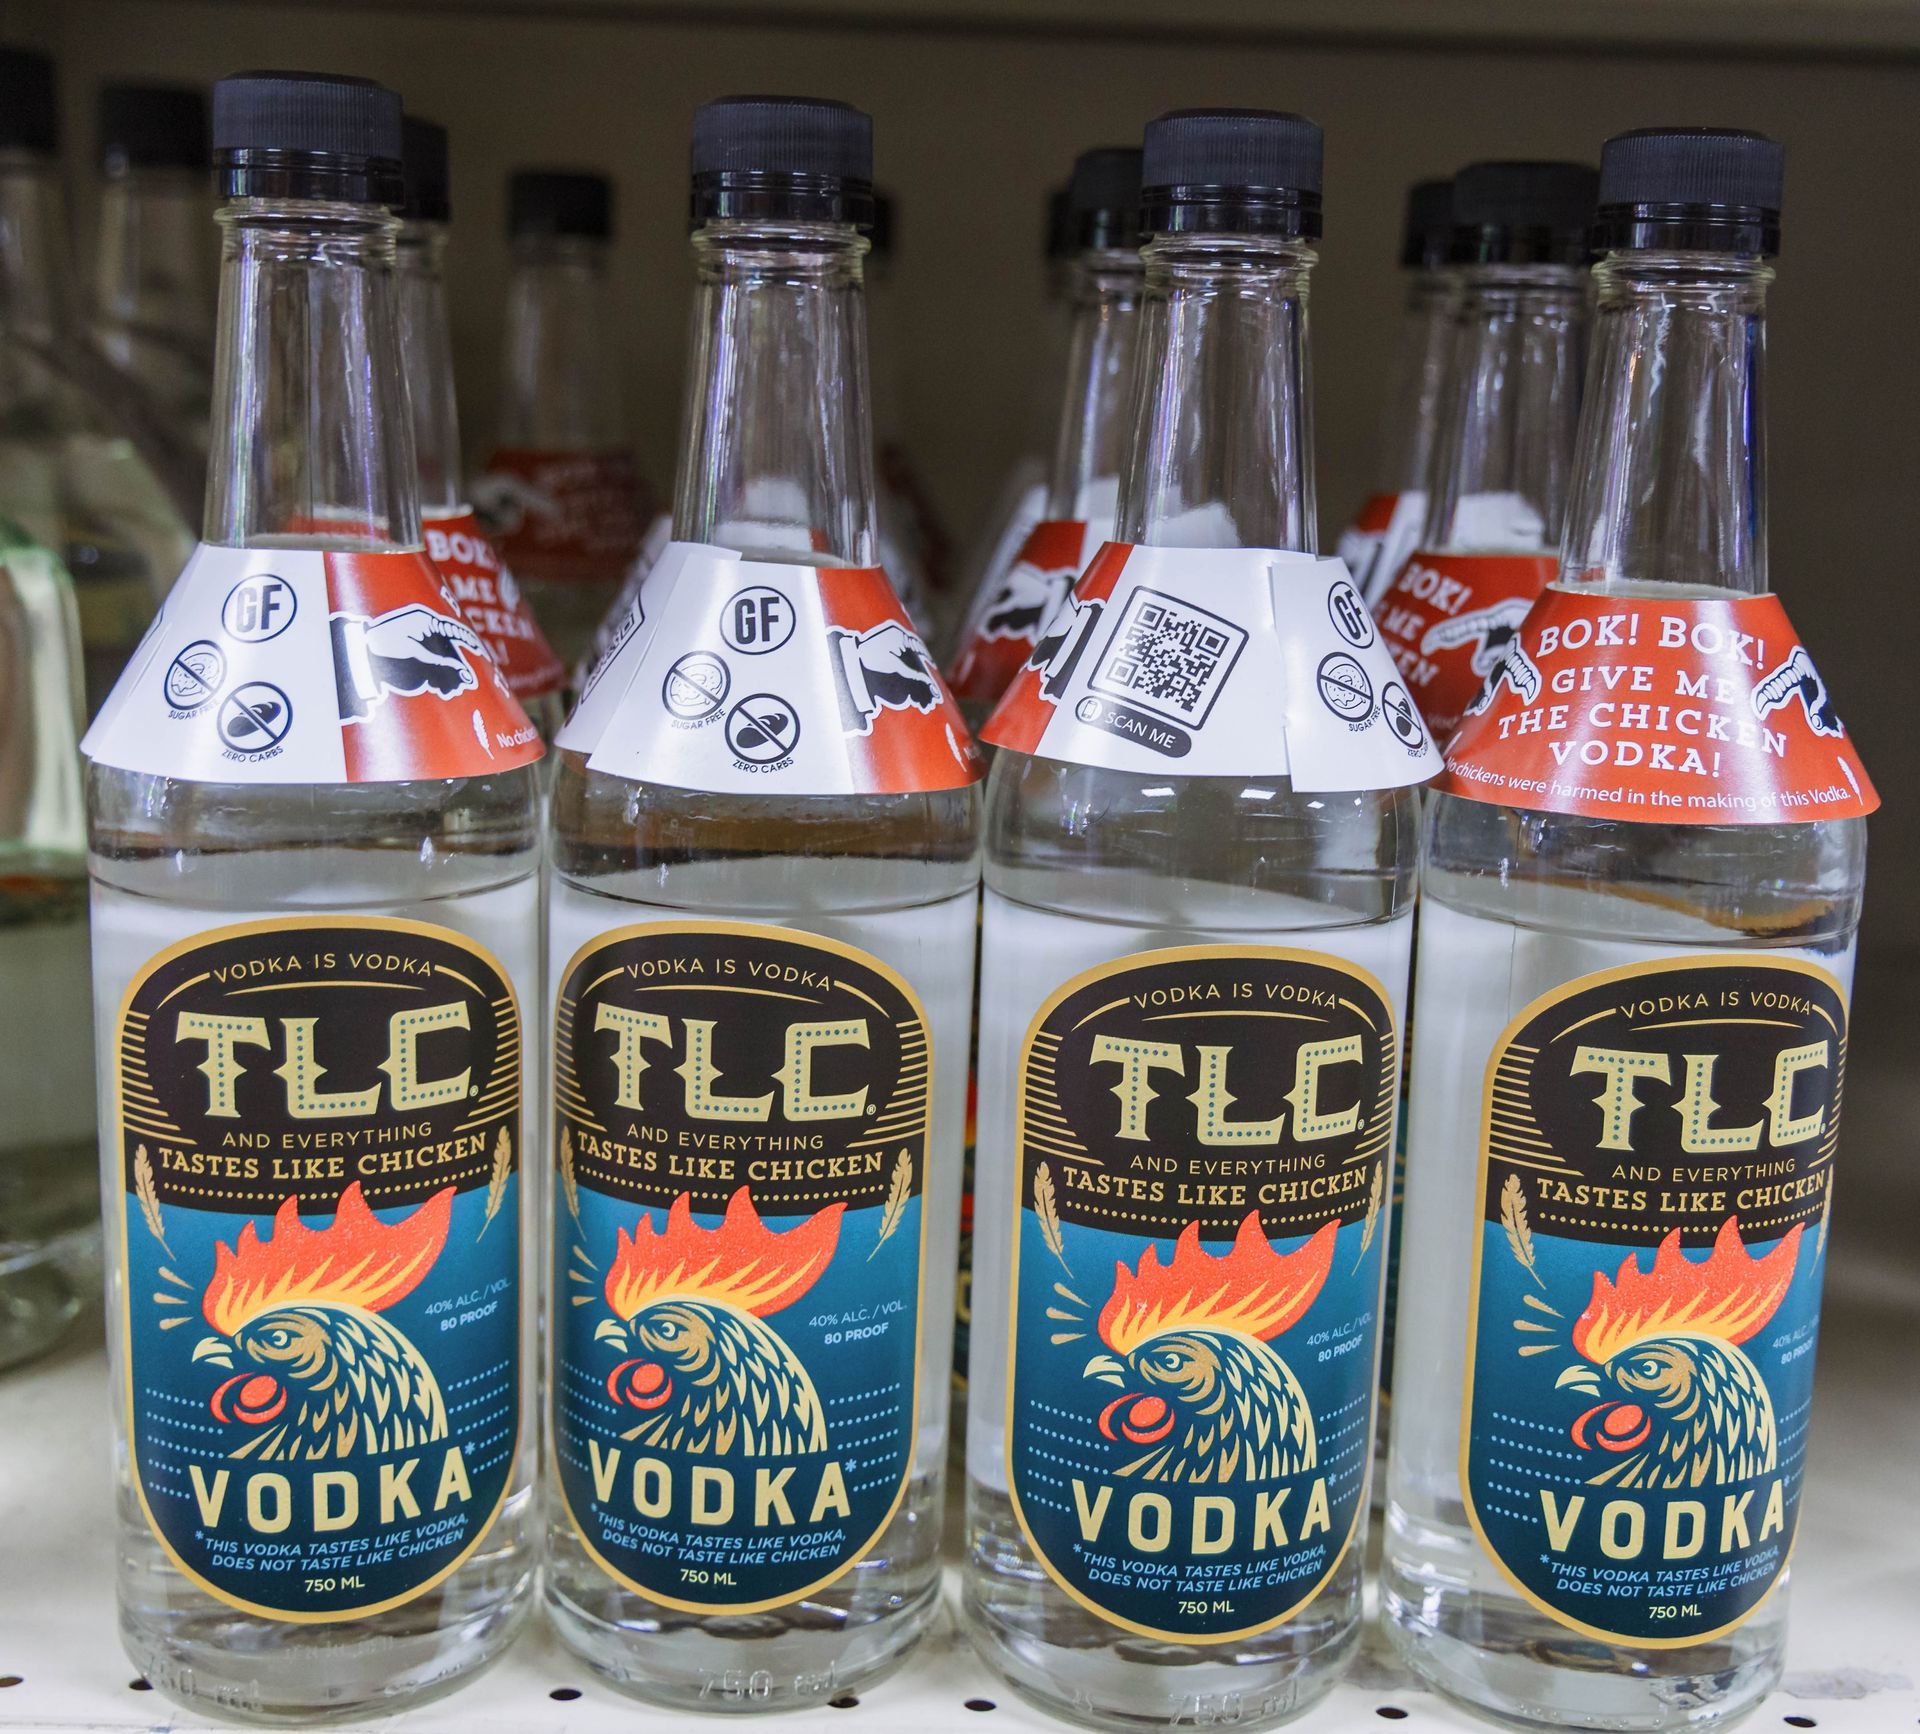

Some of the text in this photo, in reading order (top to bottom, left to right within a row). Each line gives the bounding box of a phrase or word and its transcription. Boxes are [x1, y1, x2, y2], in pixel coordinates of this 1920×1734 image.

[237, 584, 282, 632] GF
[734, 596, 782, 645] GF
[1334, 591, 1368, 646] GF
[1536, 614, 1766, 670] BOK! BOK!
[1551, 666, 1739, 704] GIVE ME
[671, 708, 726, 731] SUGAR FREE
[1105, 711, 1176, 749] SCAN ME
[1348, 718, 1373, 732] SUGAR
[1499, 705, 1568, 740] THE
[1588, 702, 1787, 760] CHICKEN
[496, 732, 515, 748] No
[221, 746, 284, 763] ZERO CARBS
[732, 756, 794, 774] ZERO CARBS
[1550, 740, 1720, 778] VODKA!
[1455, 763, 1506, 786] chickens
[1508, 777, 1547, 793] were
[1551, 780, 1623, 803] harmed
[1628, 789, 1645, 804] in
[1650, 791, 1682, 807] the
[1688, 793, 1757, 811] making
[1759, 790, 1777, 807] of
[1780, 791, 1809, 807] this
[1808, 786, 1850, 804] Vodka.
[214, 953, 432, 983] VODKA IS VODKA
[627, 959, 831, 992] VODKA IS VODKA
[1133, 983, 1336, 1009] VODKA IS VODKA
[1621, 992, 1811, 1019] VODKA IS VODKA
[223, 1122, 432, 1148] AND EVERYTHING
[627, 1124, 825, 1150] AND EVERYTHING
[159, 1132, 486, 1179] TASTES LIKE CHICKEN
[577, 1131, 883, 1180] TASTES LIKE CHICKEN
[1130, 1154, 1325, 1176] AND EVERYTHING
[1612, 1158, 1795, 1183] AND EVERYTHING
[1063, 1166, 1367, 1205] TASTES LIKE CHICKEN
[1537, 1170, 1825, 1212] TASTES LIKE CHICKEN
[425, 1299, 453, 1315] 40%
[440, 1301, 498, 1331] 80 PROOF
[809, 1314, 838, 1327] 40%
[824, 1322, 889, 1345] 80 PROOF
[1306, 1331, 1330, 1346] 40%
[1318, 1334, 1363, 1362] 80 PROOF
[243, 1542, 301, 1555] VODKA
[309, 1538, 369, 1555] TASTES
[374, 1530, 410, 1549] LIKE
[602, 1529, 841, 1563] DOES NOT TASTE LIKE CHICKEN
[629, 1524, 679, 1544] VODKA
[685, 1534, 743, 1549] TASTES
[748, 1537, 783, 1549] LIKE
[212, 1529, 463, 1571] DOES NOT TASTE LIKE CHICKEN
[680, 1568, 737, 1586] 750 ML
[1088, 1559, 1322, 1592] DOES NOT TASTE LIKE CHICKEN
[1122, 1560, 1178, 1577] VODKA
[1185, 1564, 1241, 1577] TASTES
[1246, 1558, 1278, 1574] LIKE
[1556, 1560, 1776, 1597] DOES NOT TASTE LIKE CHICKEN
[1593, 1568, 1649, 1582] VODKA
[1656, 1568, 1708, 1582] TASTES
[1713, 1560, 1742, 1577] LIKE
[305, 1576, 365, 1592] 750 ML
[1178, 1599, 1234, 1614] 750 ML
[1649, 1604, 1702, 1619] 750 ML
